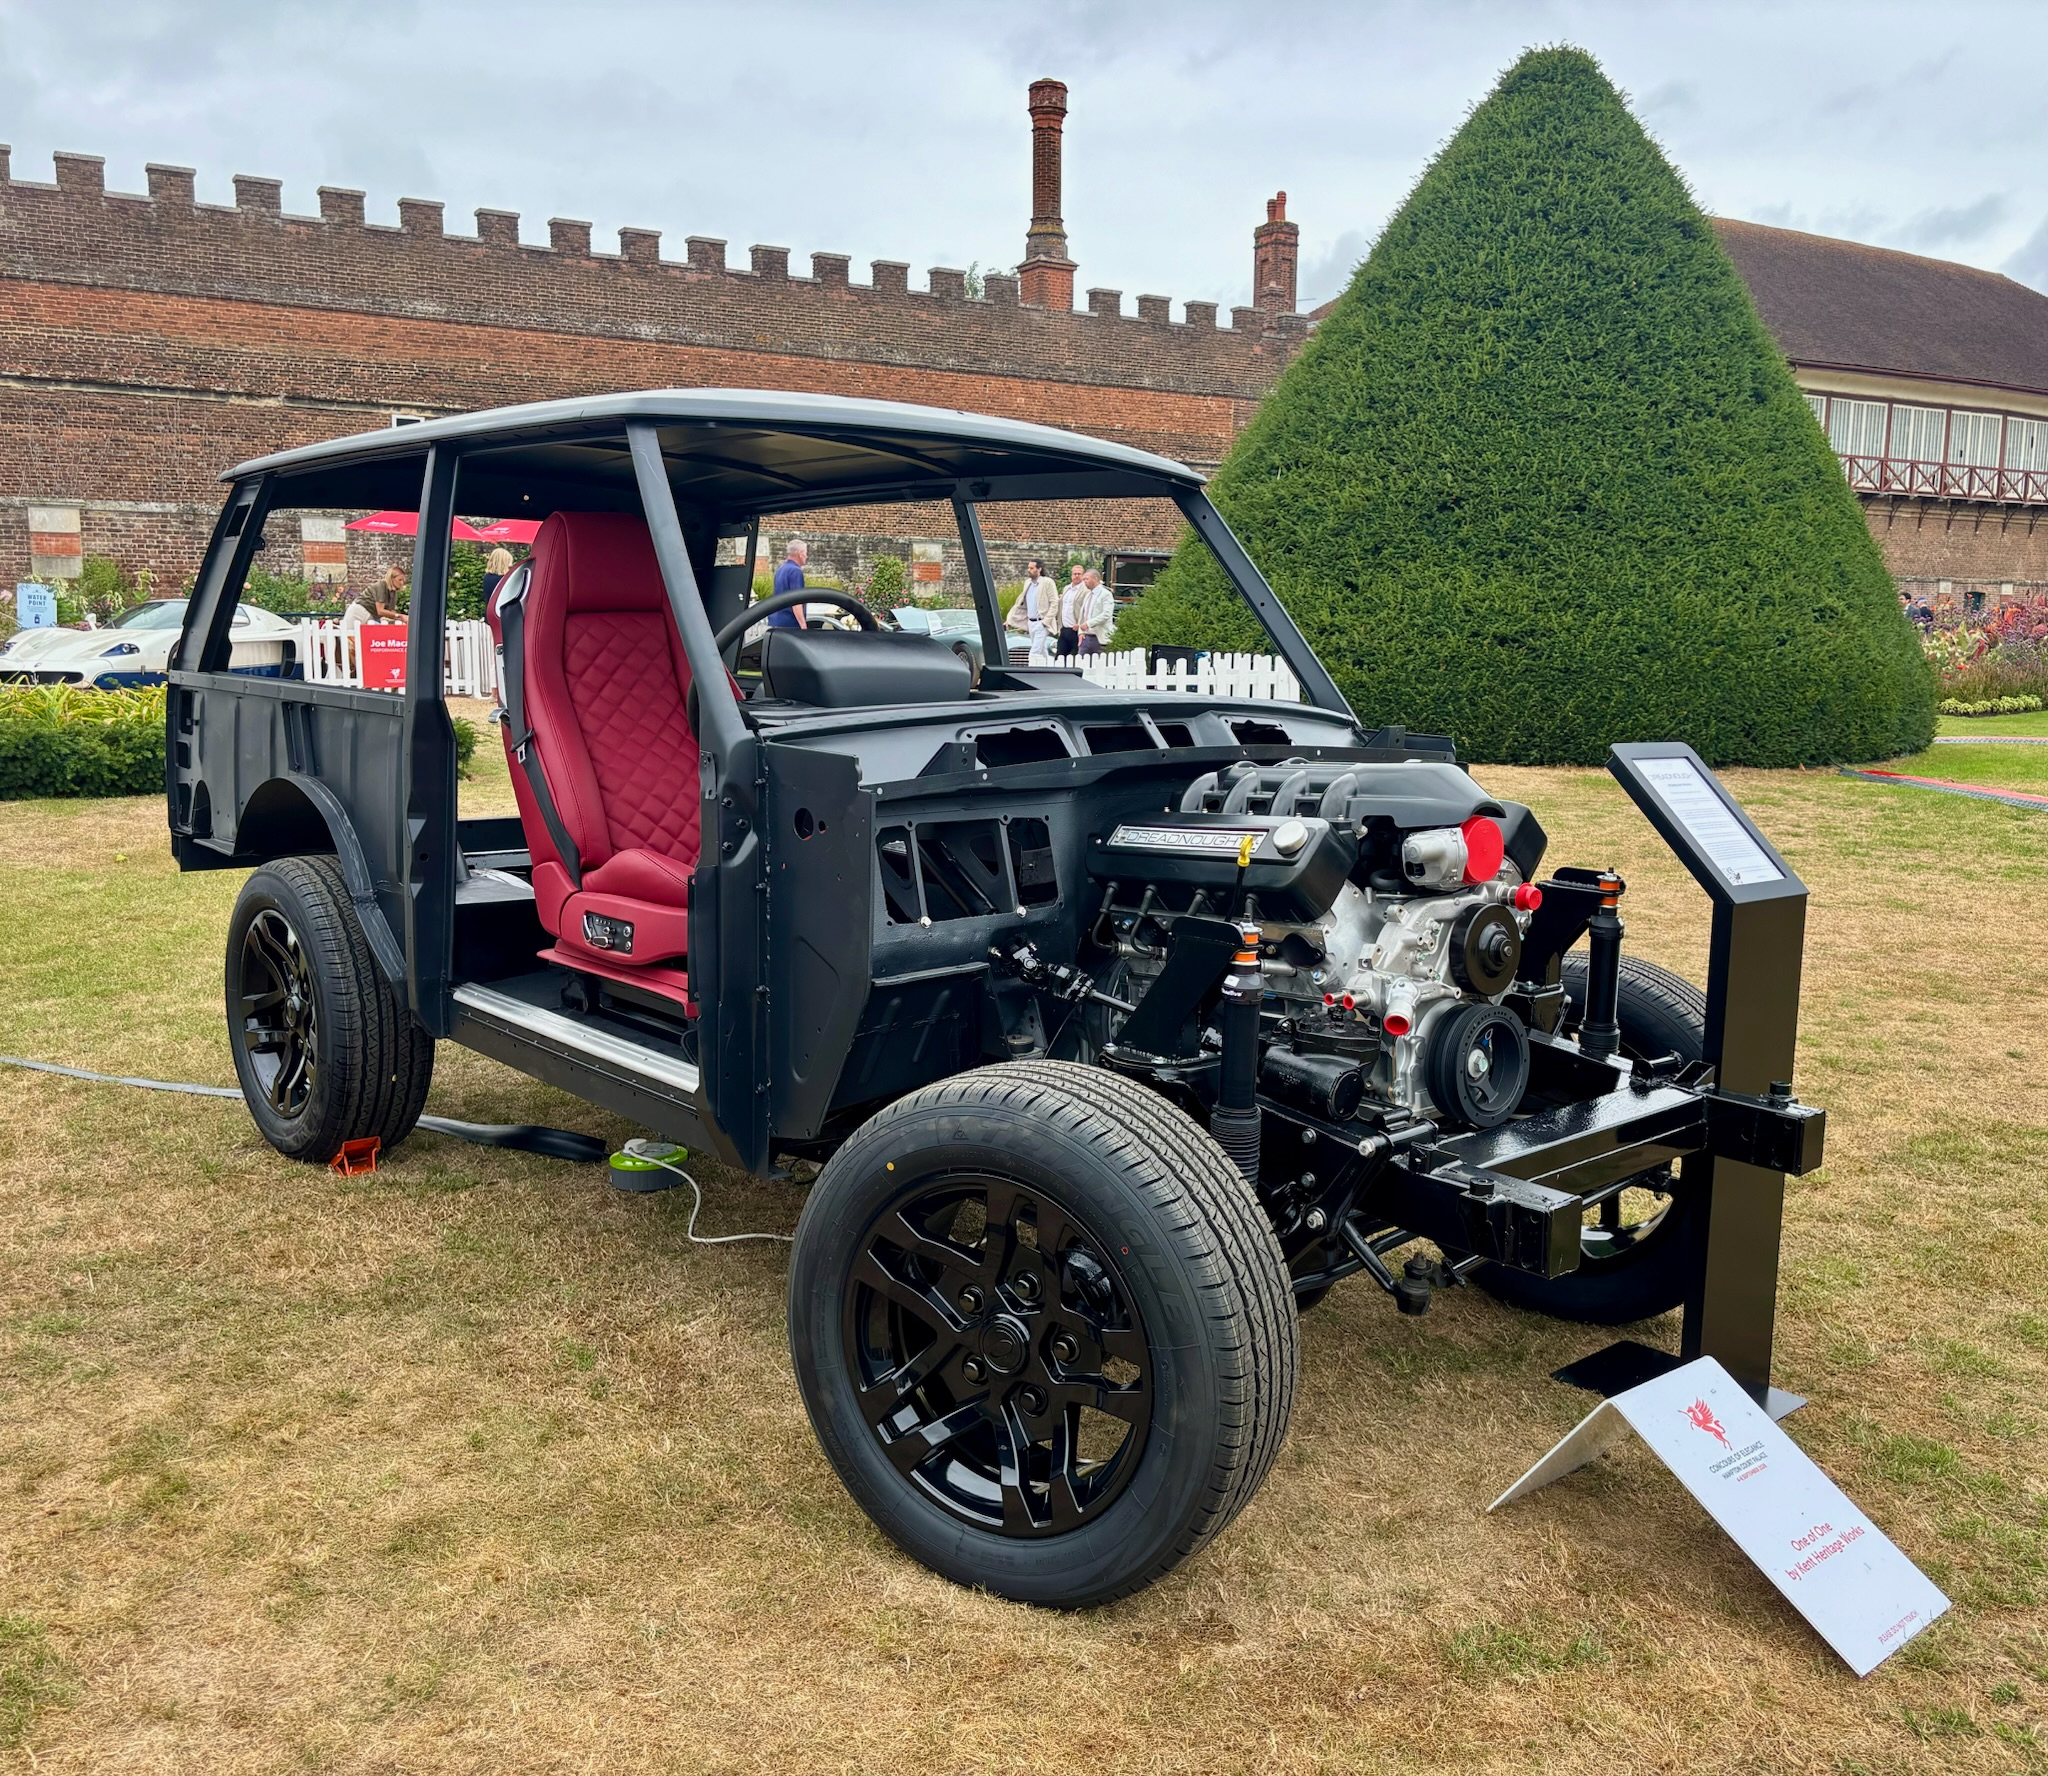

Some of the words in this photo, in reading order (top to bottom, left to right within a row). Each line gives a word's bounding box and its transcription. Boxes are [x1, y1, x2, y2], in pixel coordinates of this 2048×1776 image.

[370, 639, 386, 648] Joe
[387, 639, 408, 648] Mac
[979, 1119, 1192, 1335] TRIANGLE
[1708, 1455, 1737, 1474] CONCOURS
[1733, 1451, 1743, 1461] OF
[1739, 1440, 1765, 1457] ELEGANCE
[1721, 1465, 1742, 1480] HAMPTON
[1739, 1458, 1754, 1470] COURT
[1751, 1451, 1768, 1464] PALACE
[834, 1456, 866, 1497] SUV
[1784, 1569, 1802, 1581] by
[1794, 1556, 1818, 1575] Kent
[1810, 1539, 1845, 1564] Heritage
[1838, 1526, 1865, 1545] Works
[1790, 1537, 1811, 1552] One
[1807, 1529, 1818, 1542] of
[1813, 1522, 1833, 1537] One
